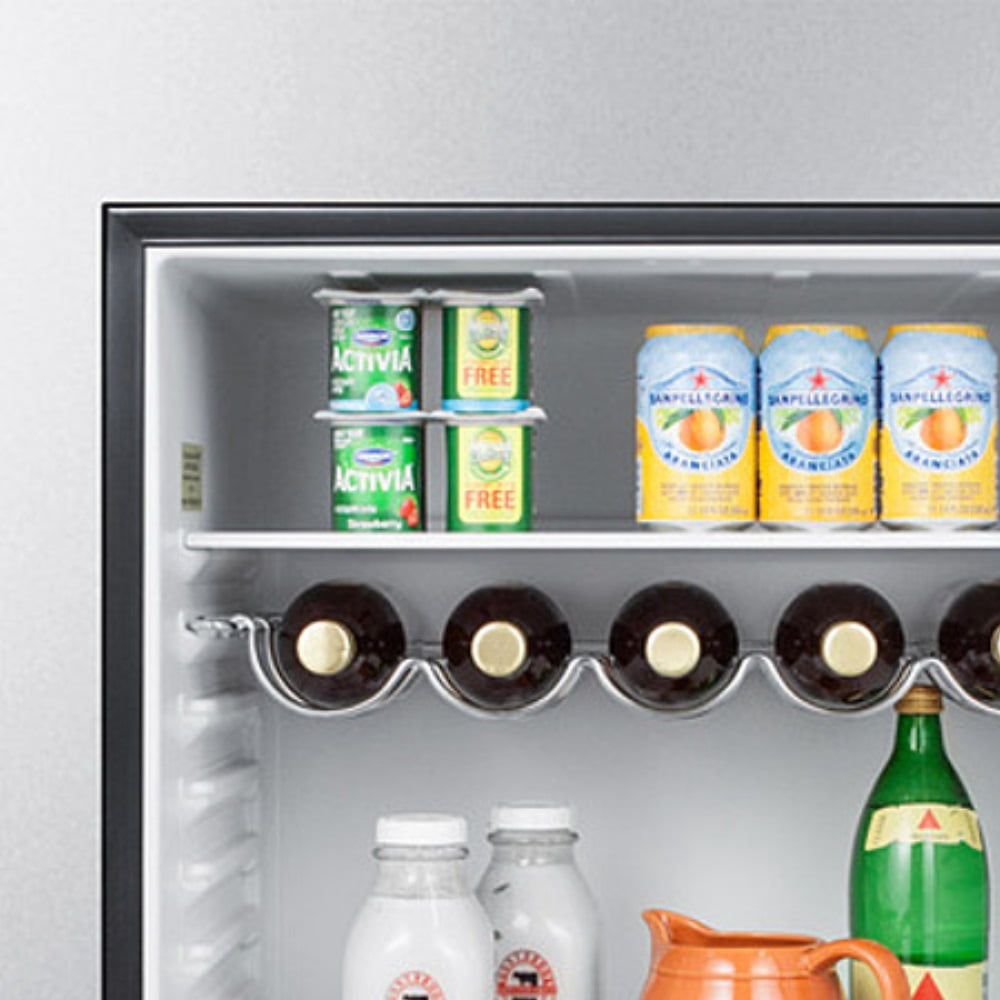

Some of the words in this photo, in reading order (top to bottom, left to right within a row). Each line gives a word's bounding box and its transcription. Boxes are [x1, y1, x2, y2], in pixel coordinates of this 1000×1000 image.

[331, 346, 412, 372] ACTIVIA
[463, 366, 513, 387] FREE
[334, 464, 416, 492] ACTIVIA
[465, 489, 516, 510] FREE
